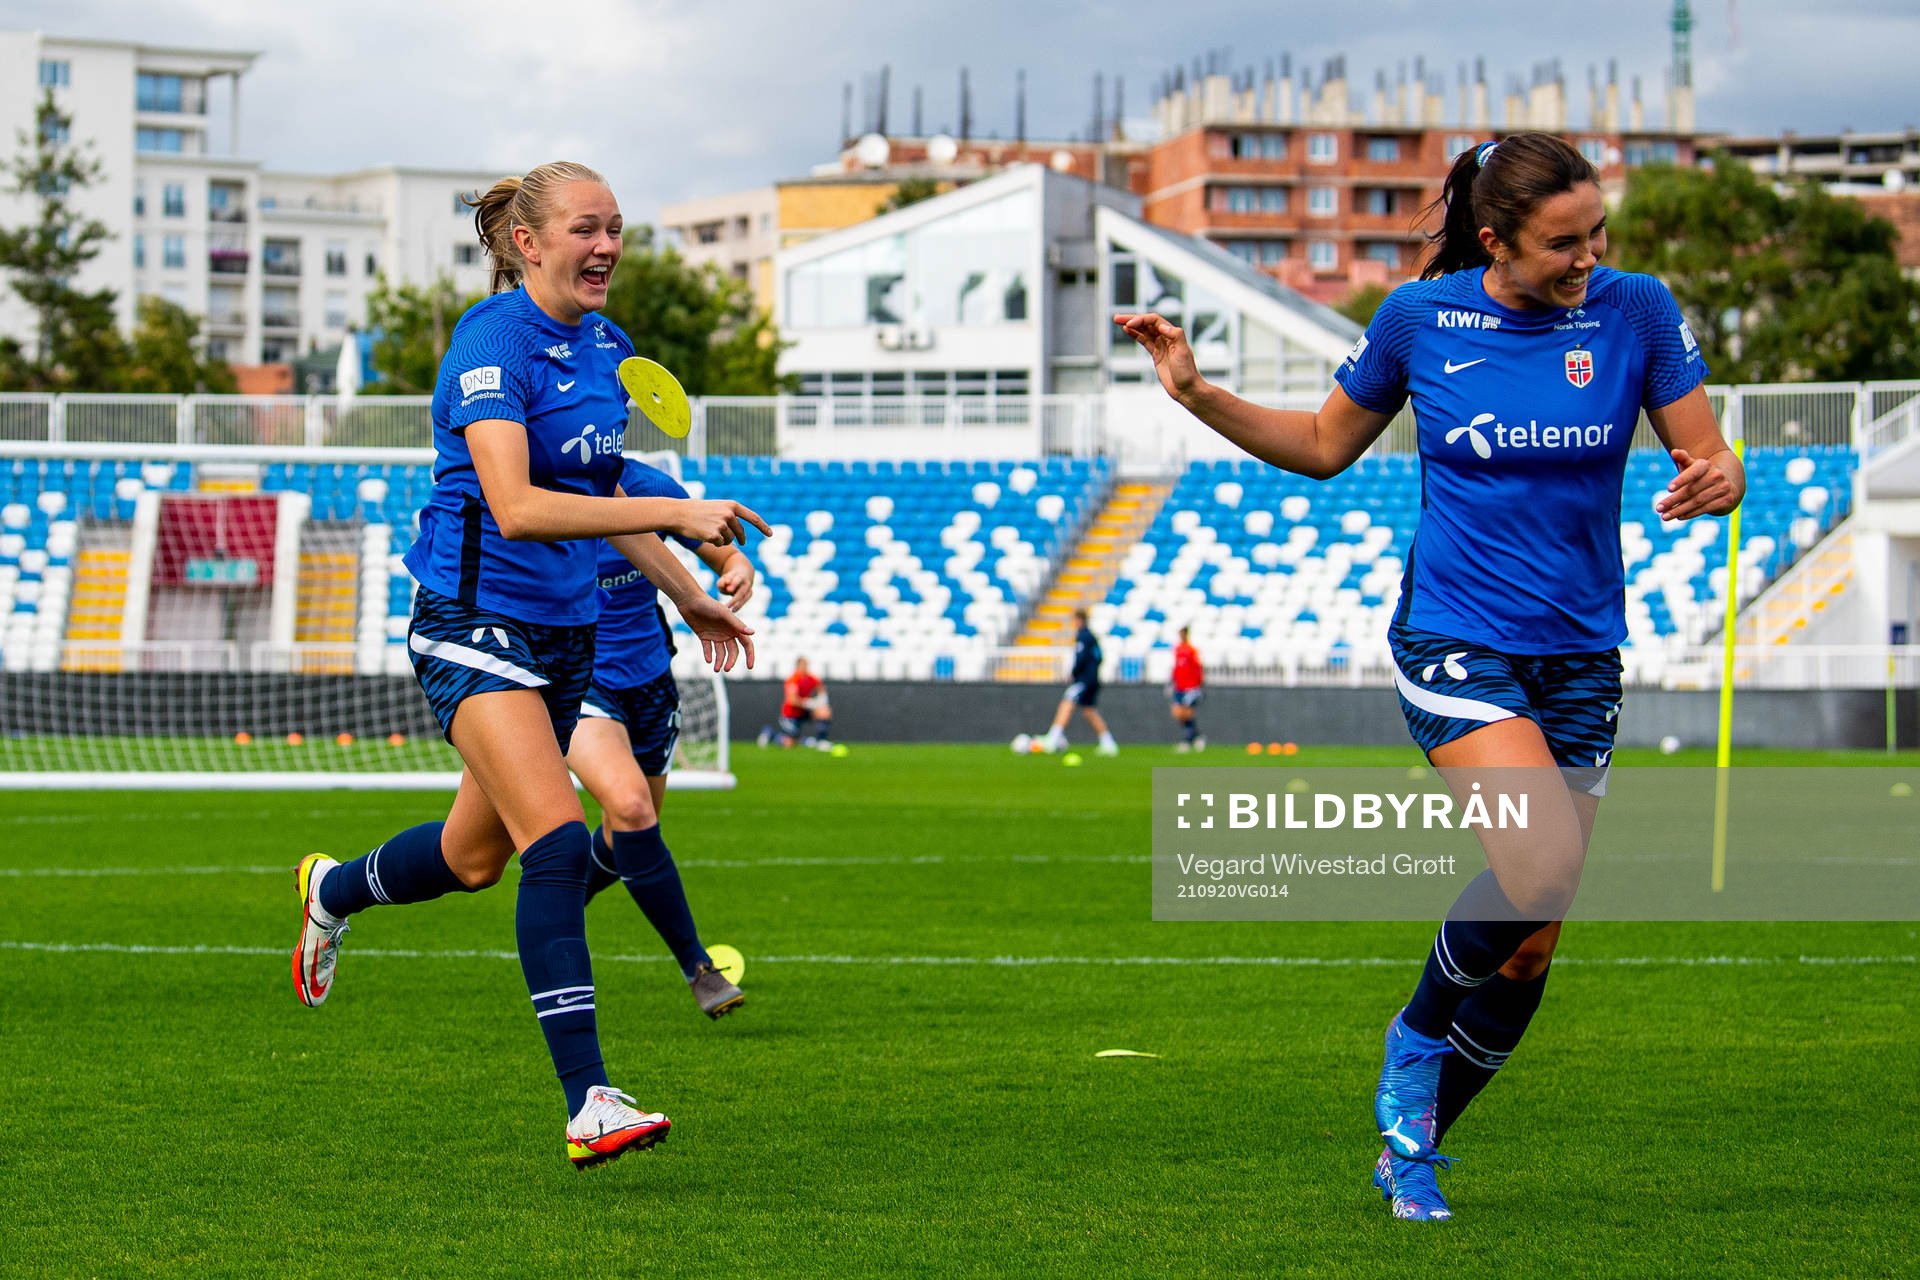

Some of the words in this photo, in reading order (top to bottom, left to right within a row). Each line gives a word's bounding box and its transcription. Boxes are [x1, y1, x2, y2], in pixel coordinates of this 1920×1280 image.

[1437, 310, 1481, 329] KIWI
[1574, 320, 1601, 330] Tipping
[464, 368, 495, 391] DNB
[1495, 419, 1613, 449] telenor
